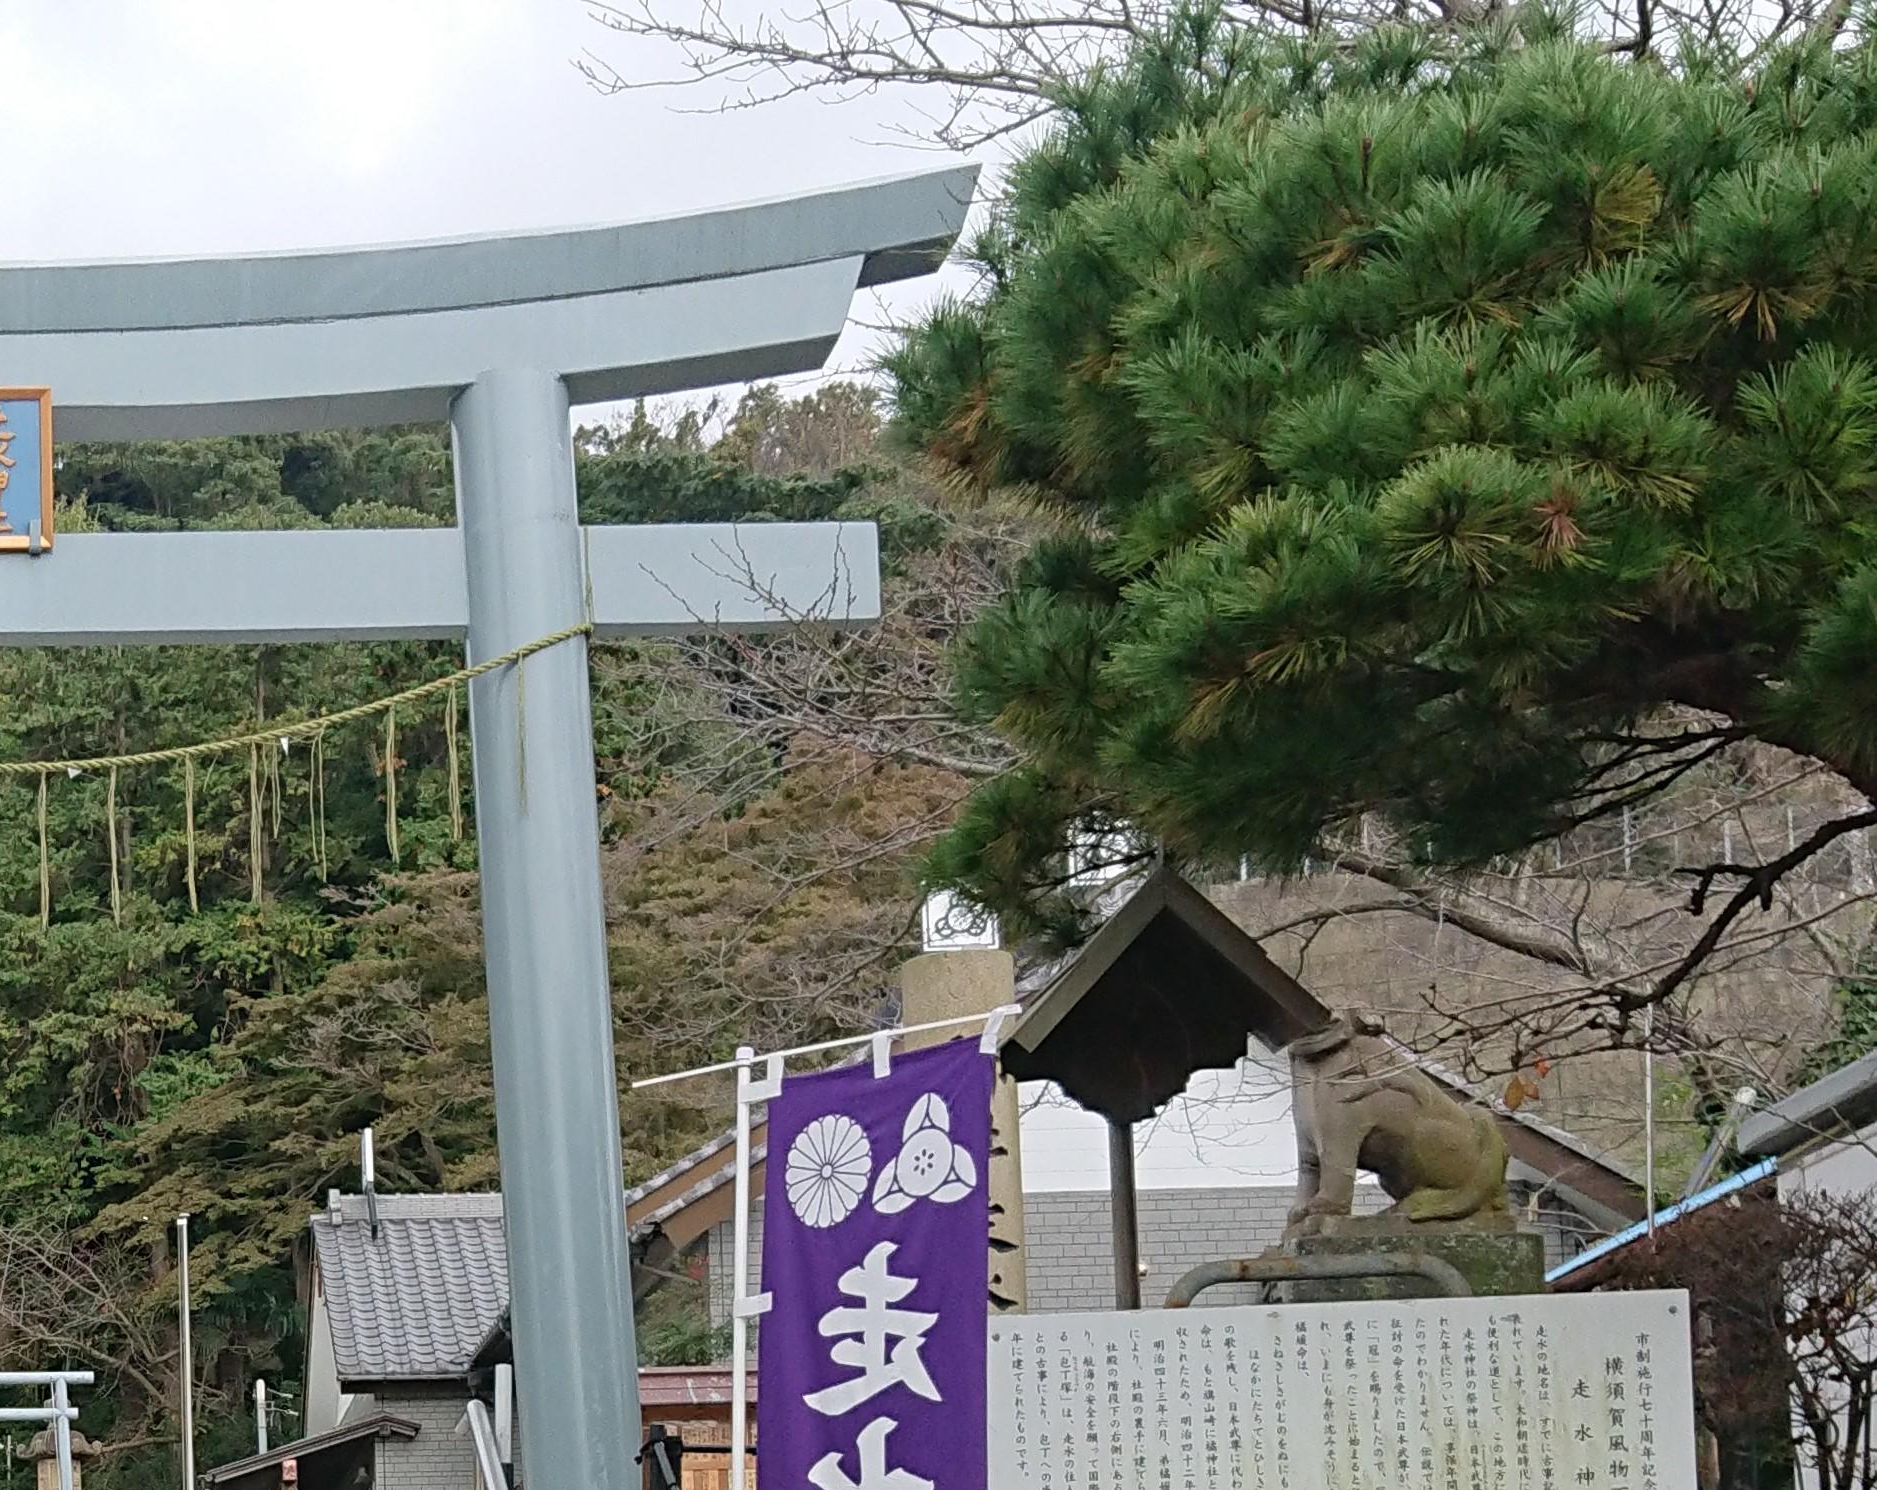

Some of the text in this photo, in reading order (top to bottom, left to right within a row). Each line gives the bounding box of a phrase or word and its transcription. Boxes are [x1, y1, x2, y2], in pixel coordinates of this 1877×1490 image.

[1009, 1331, 1029, 1477] 年に建てられたものです。
